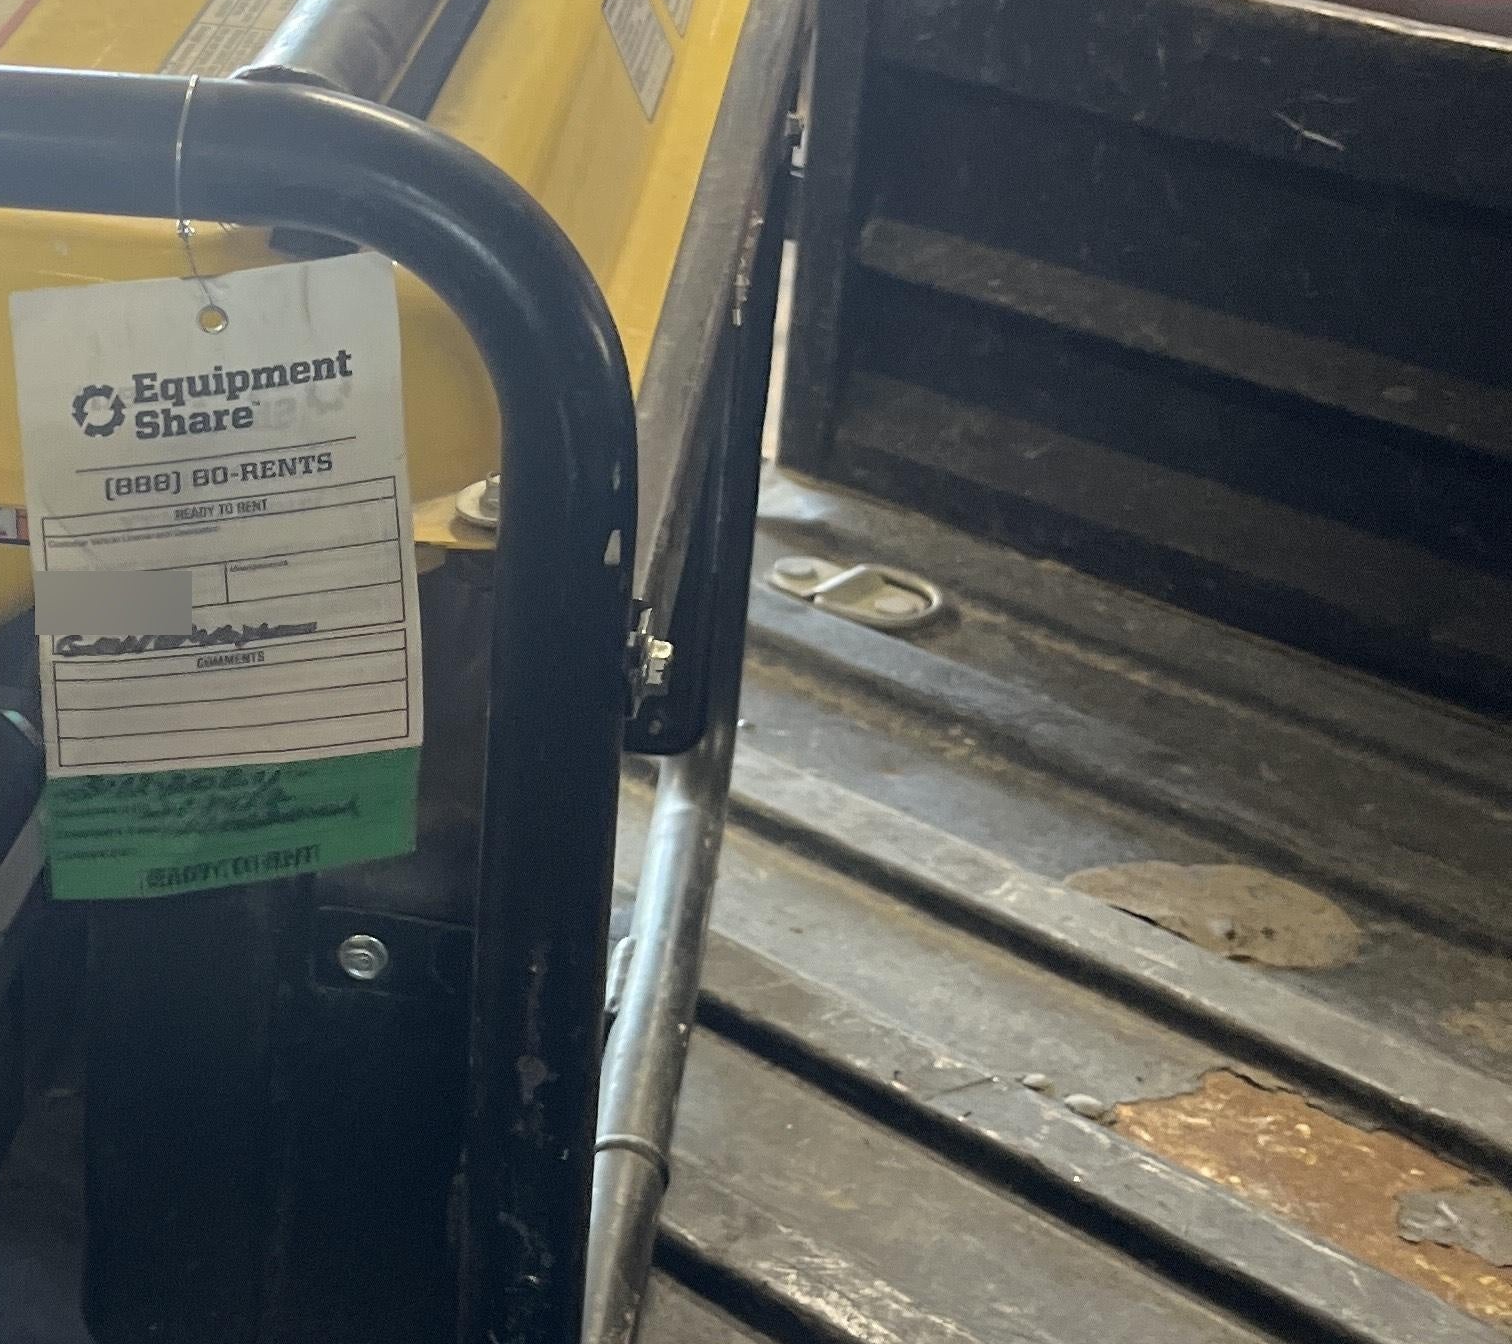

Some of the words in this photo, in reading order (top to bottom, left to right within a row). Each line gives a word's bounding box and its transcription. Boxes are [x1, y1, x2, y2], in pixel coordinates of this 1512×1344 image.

[131, 348, 353, 407] Equipment
[134, 405, 254, 440] Share
[104, 470, 182, 501] (888)
[174, 503, 215, 521] READY
[218, 502, 234, 515] TO
[236, 498, 268, 514] RENT
[196, 650, 265, 669] COMMENTS
